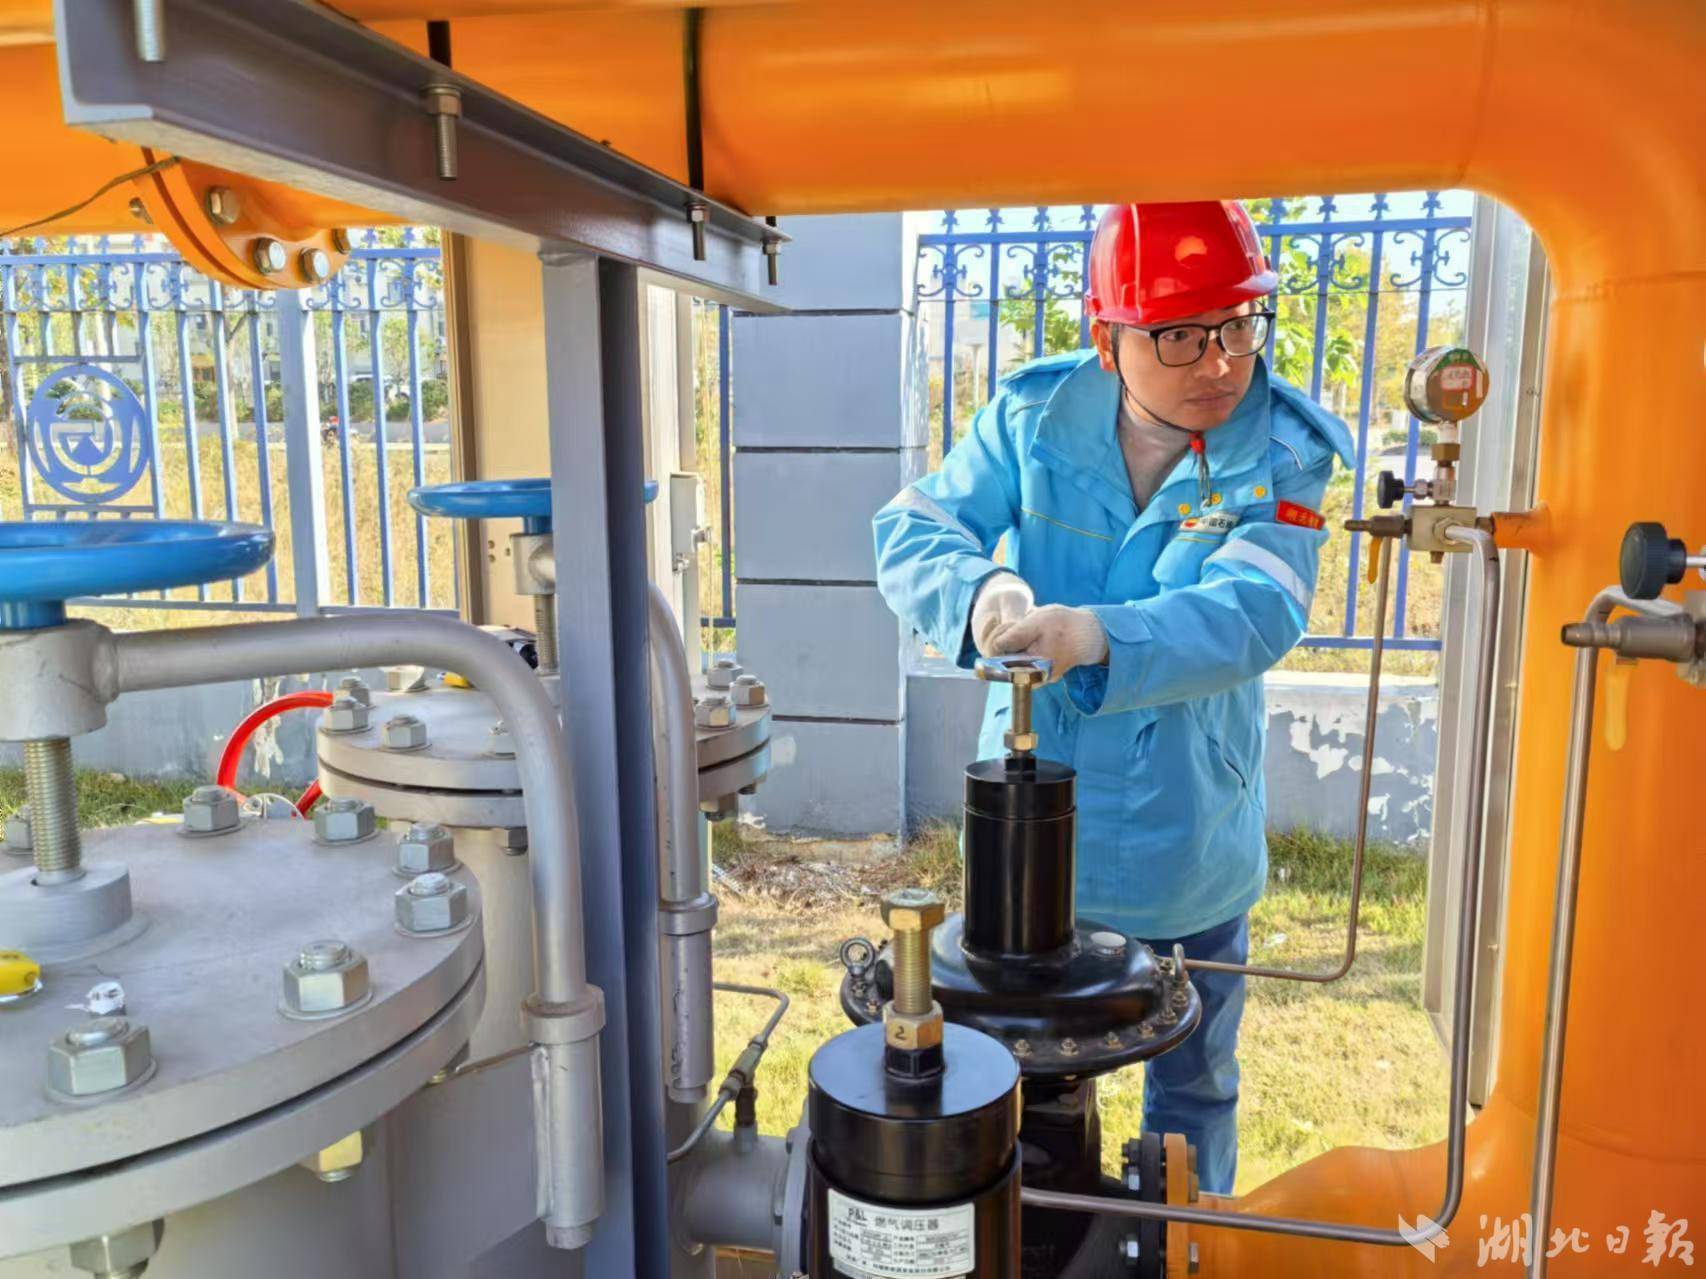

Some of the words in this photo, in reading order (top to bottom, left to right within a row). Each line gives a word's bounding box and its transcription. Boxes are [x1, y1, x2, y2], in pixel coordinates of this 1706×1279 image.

[874, 1216, 939, 1231] 燃气调压器
